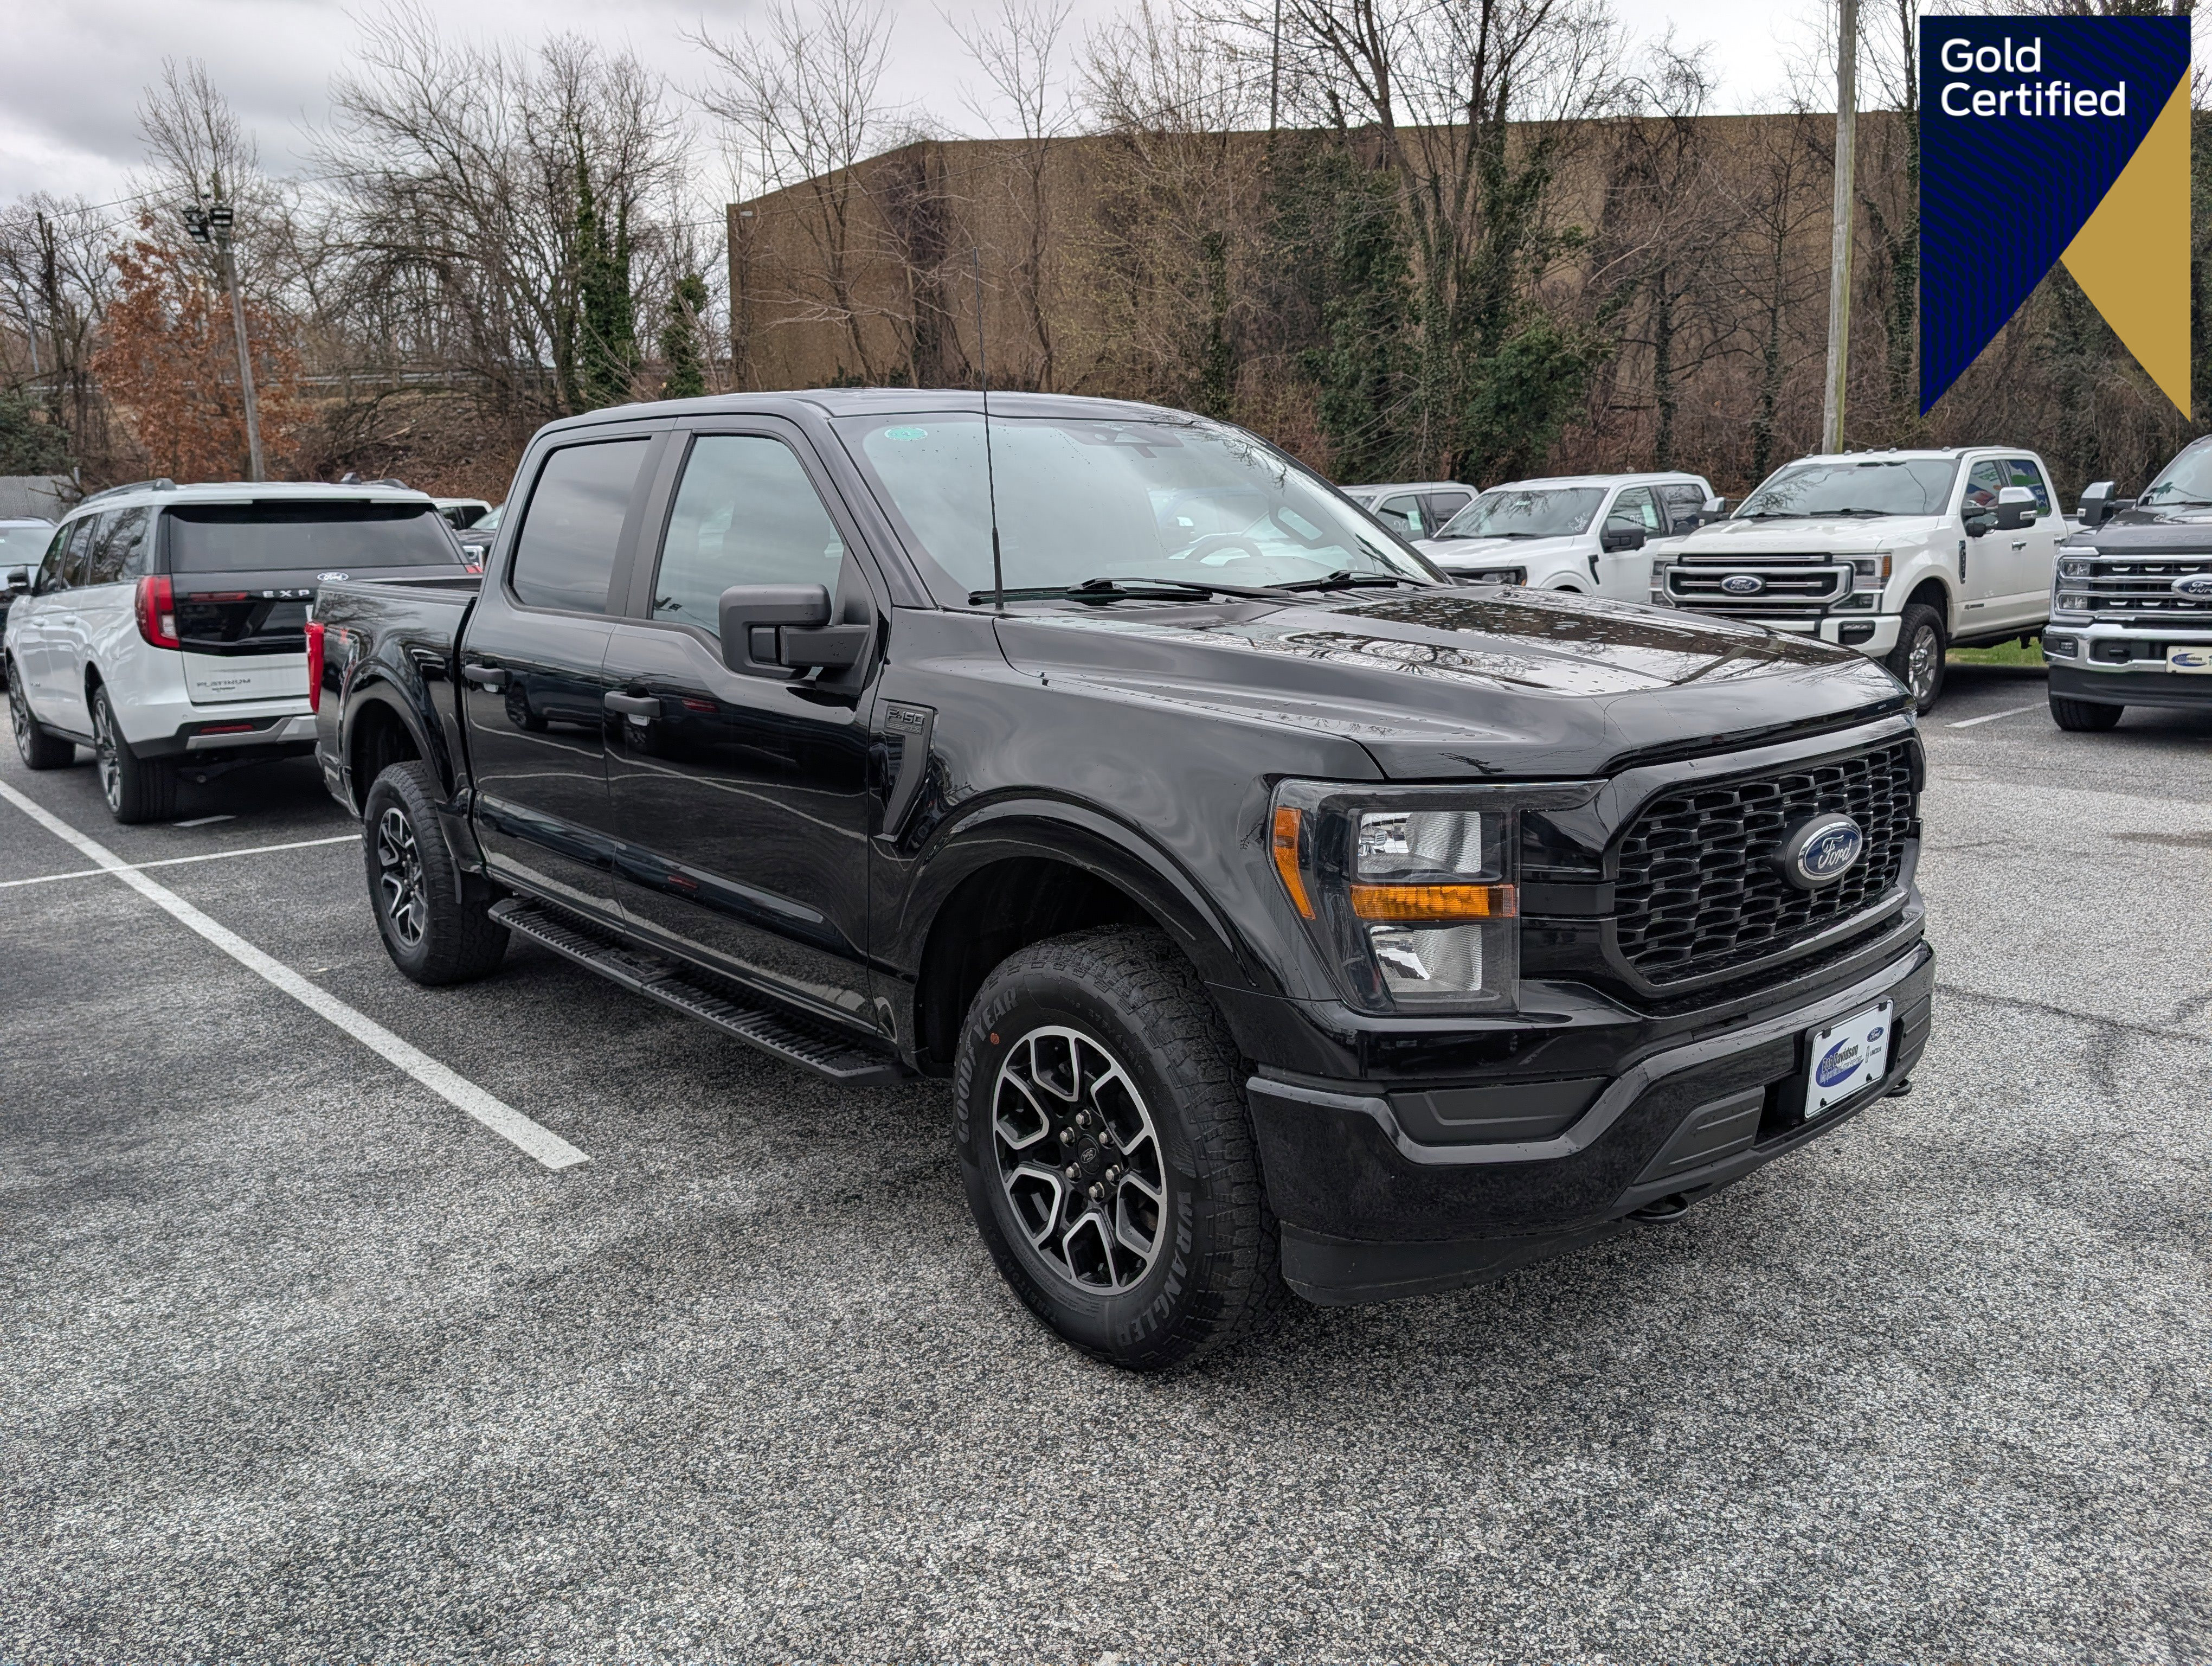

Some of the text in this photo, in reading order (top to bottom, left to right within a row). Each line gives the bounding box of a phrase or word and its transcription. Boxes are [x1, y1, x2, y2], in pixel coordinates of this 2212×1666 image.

[1729, 579, 1752, 589] Ford
[2188, 581, 2212, 593] For
[196, 678, 251, 687] PLATINUM
[1817, 834, 1854, 869] Ford
[957, 987, 1019, 1143] GOODYEAR
[1822, 1055, 1834, 1074] Bob
[1834, 1044, 1859, 1066] Davidson
[1116, 1192, 1193, 1347] WRANGLER
